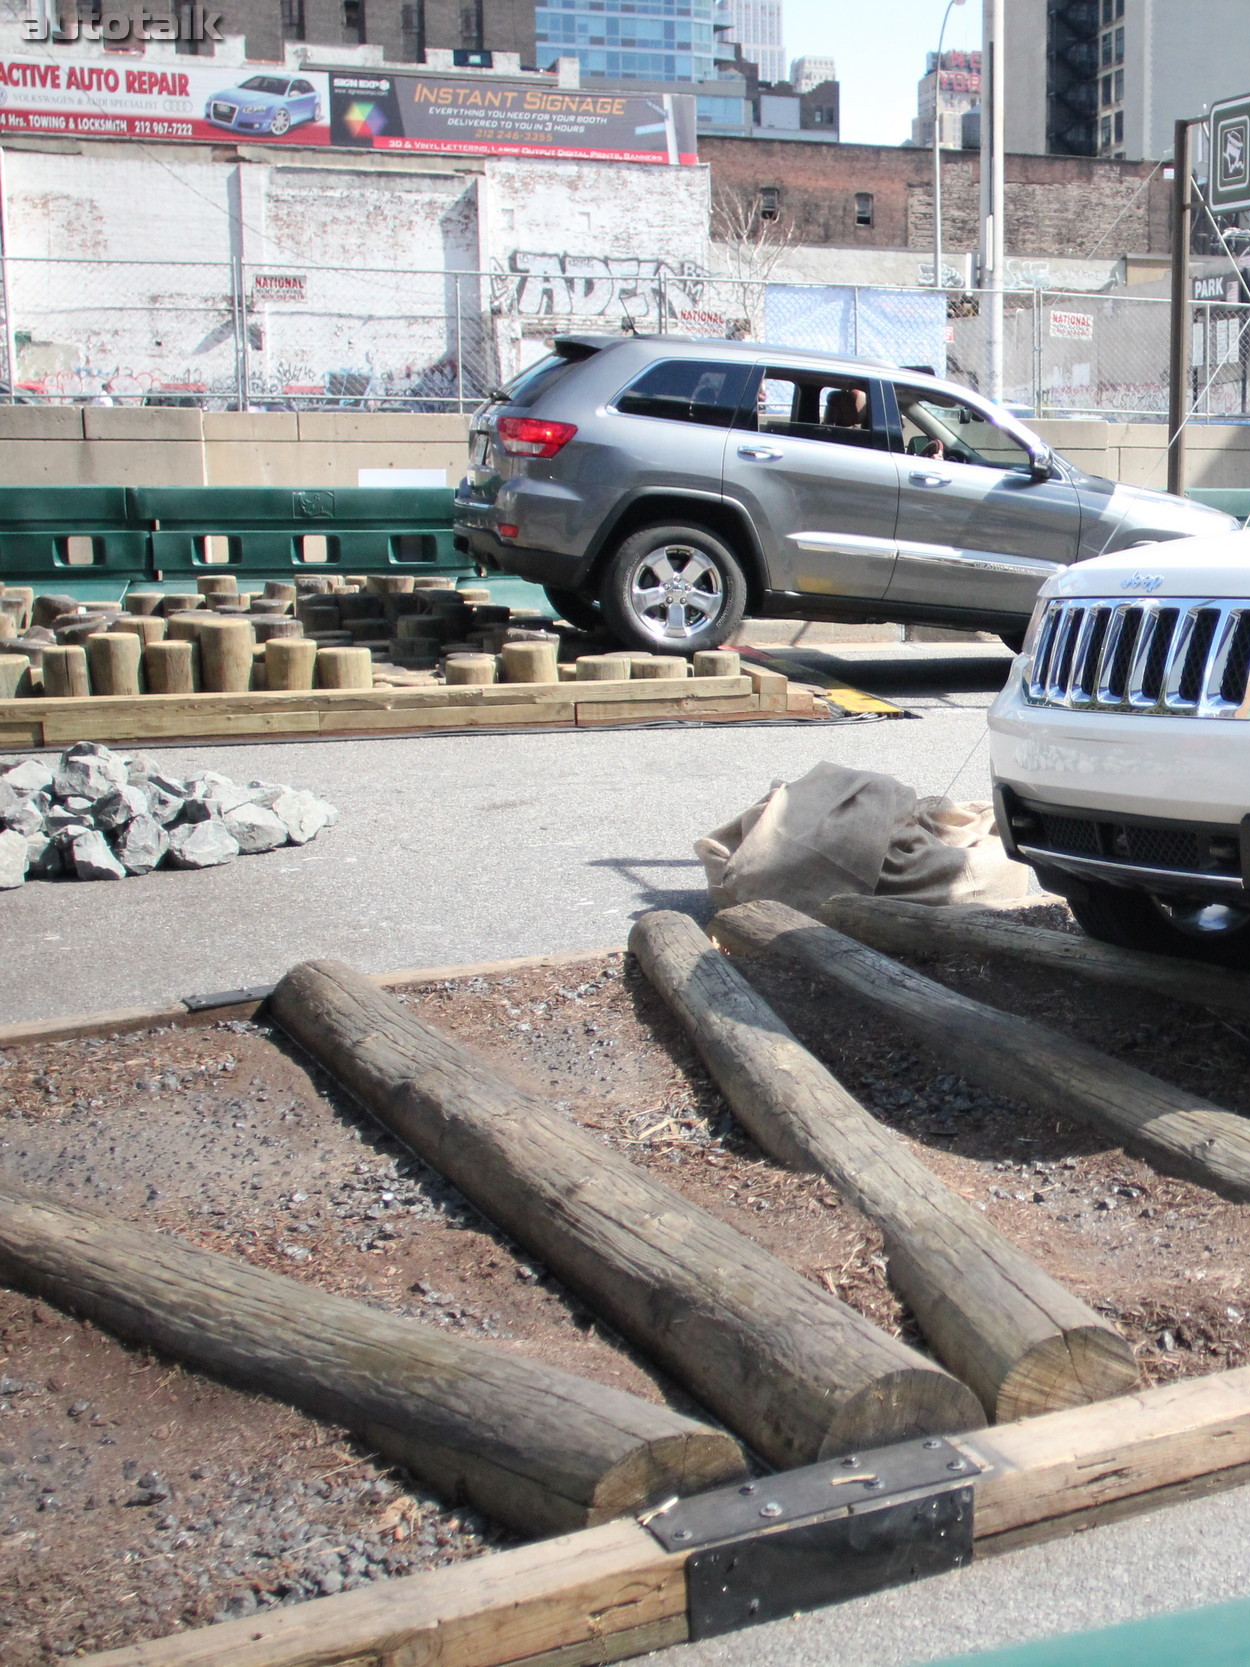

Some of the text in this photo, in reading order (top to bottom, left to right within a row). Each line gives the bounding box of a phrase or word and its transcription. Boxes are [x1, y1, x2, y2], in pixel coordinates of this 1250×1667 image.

[950, 50, 982, 68] NE
[0, 62, 190, 97] ACTIVE AUTO REPAIR
[939, 71, 982, 93] YOR
[13, 92, 158, 111] VOLKSWAGEN & AUDI SPECIALIST
[413, 83, 519, 108] INSTANT
[523, 90, 628, 115] SIGNAGE
[0, 113, 7, 125] 4
[8, 113, 27, 127] Hrs.
[28, 115, 66, 129] TOWING
[68, 117, 76, 130] &
[134, 121, 151, 133] 212
[152, 122, 193, 136] 967-7222
[428, 106, 608, 125] EVERYTHING YOU NEED FOR YOUR BOOTH
[447, 117, 586, 134] DELIVERED TO YOU IN 3 HOURS
[254, 276, 305, 289] NATIONAL
[1194, 276, 1224, 299] PARK
[681, 309, 725, 325] NATIONAL
[1052, 313, 1092, 327] NATIONAL
[1120, 569, 1165, 593] Jeep
